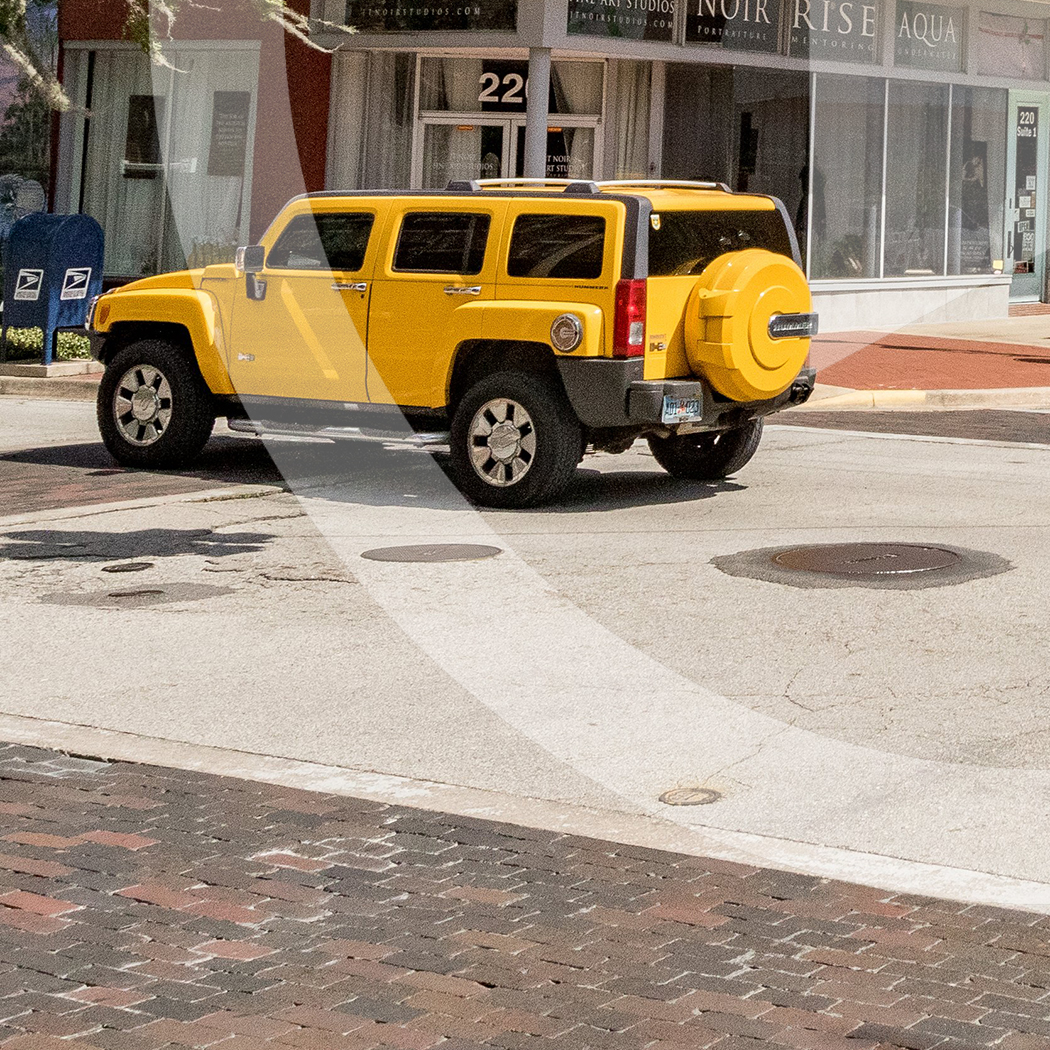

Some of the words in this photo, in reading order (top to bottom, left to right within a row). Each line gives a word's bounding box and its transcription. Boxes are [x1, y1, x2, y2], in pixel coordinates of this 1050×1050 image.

[897, 11, 957, 48] AQUA
[791, 35, 875, 51] MENTORING
[477, 72, 529, 104] 22
[1019, 111, 1035, 125] 220
[1016, 126, 1032, 137] Suite
[1032, 128, 1037, 137] 1
